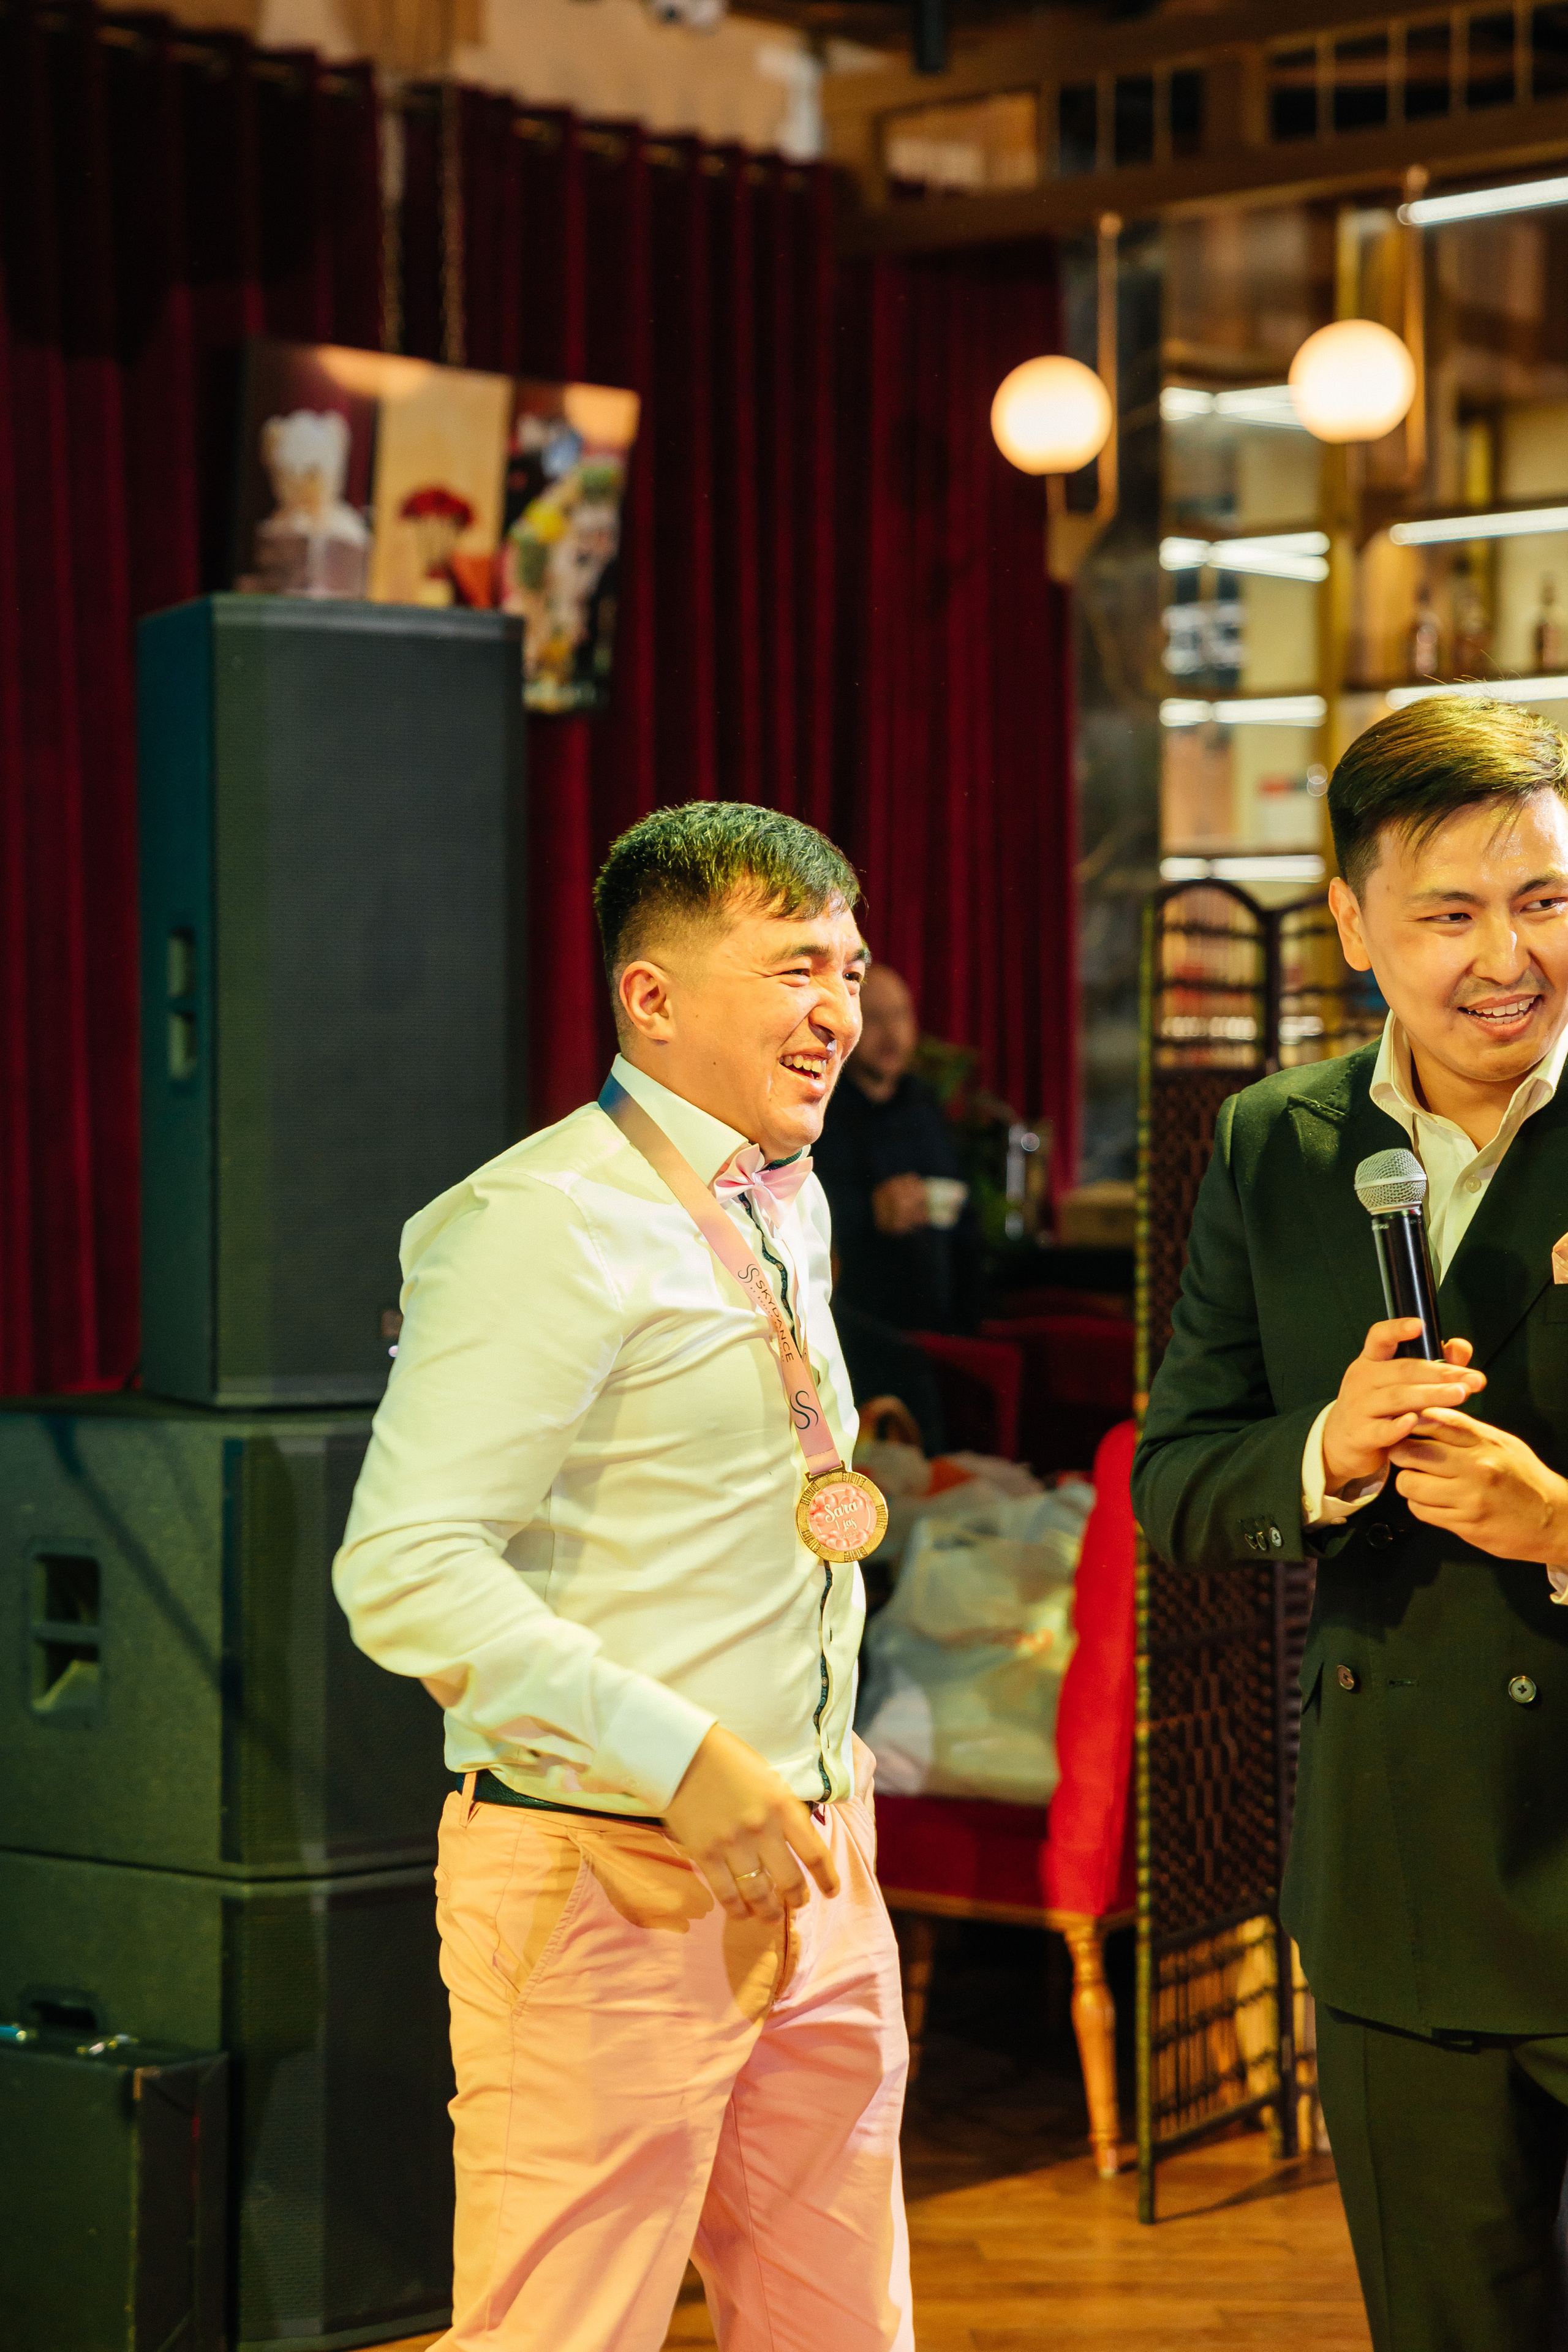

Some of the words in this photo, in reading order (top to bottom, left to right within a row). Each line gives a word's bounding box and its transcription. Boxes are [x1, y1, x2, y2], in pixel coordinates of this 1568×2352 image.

[756, 1280, 794, 1362] SKYDANCE
[824, 1501, 858, 1523] Sara
[842, 1518, 857, 1531] jas
